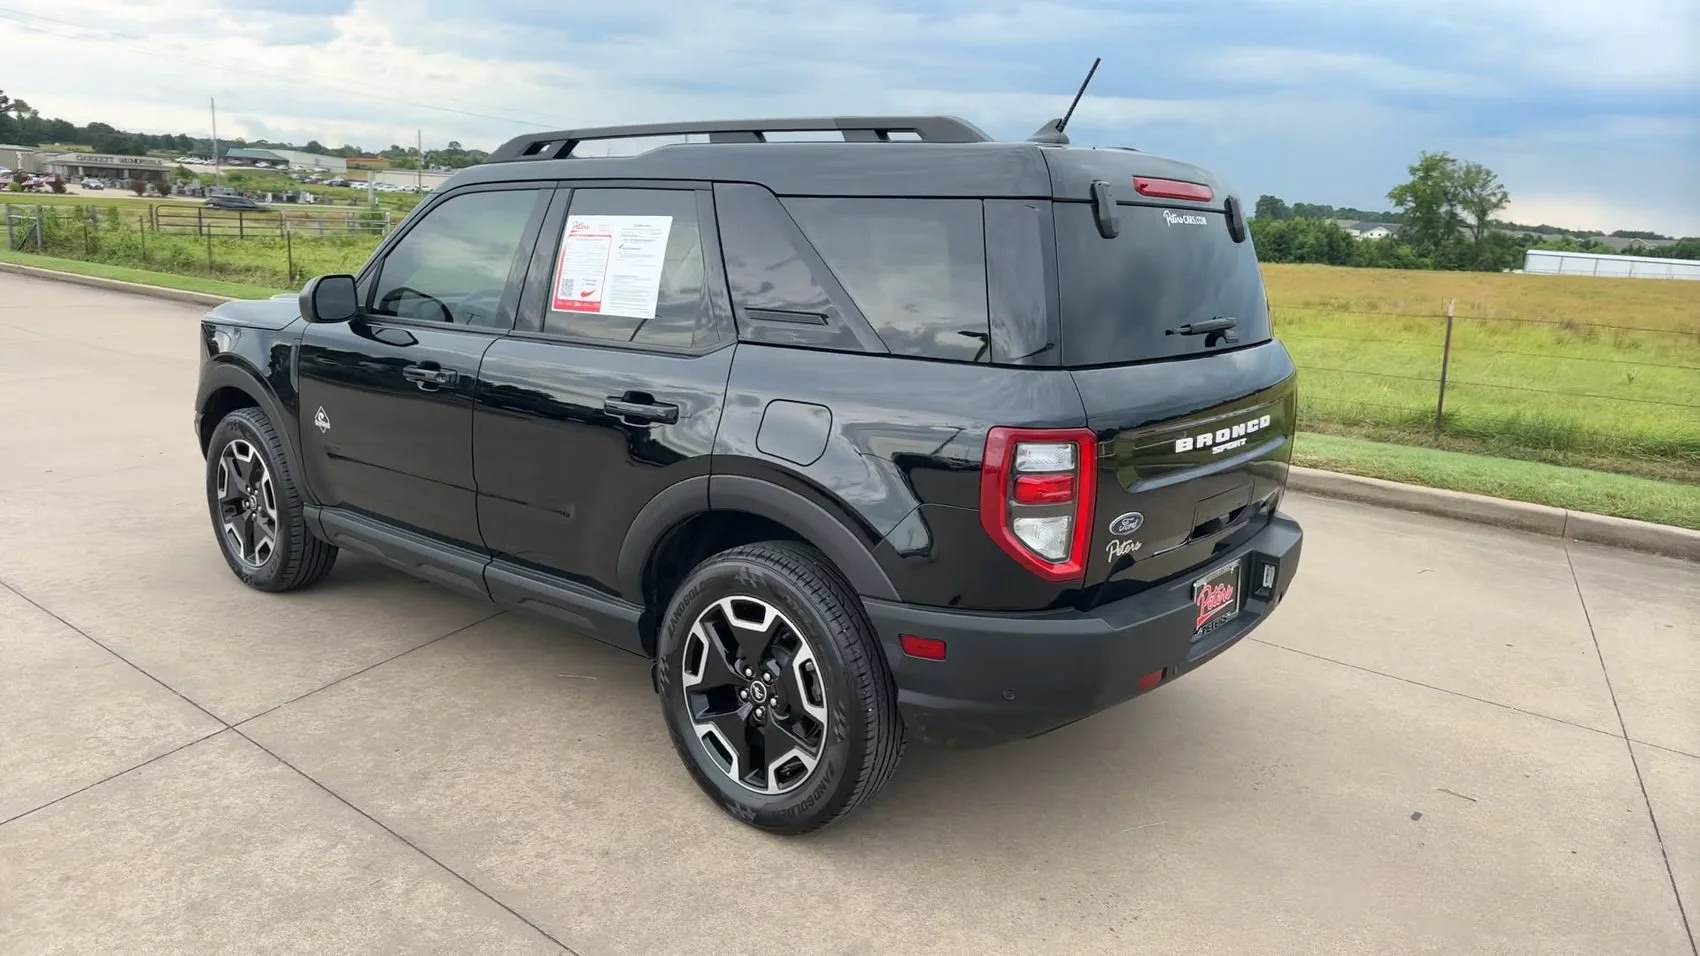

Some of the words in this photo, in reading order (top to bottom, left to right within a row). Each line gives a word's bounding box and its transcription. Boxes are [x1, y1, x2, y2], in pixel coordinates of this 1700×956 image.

[1175, 414, 1271, 453] BRONCO
[1211, 438, 1248, 454] SPORT
[1118, 517, 1139, 532] Ford
[1105, 539, 1142, 563] Peters
[1197, 583, 1234, 617] Peters
